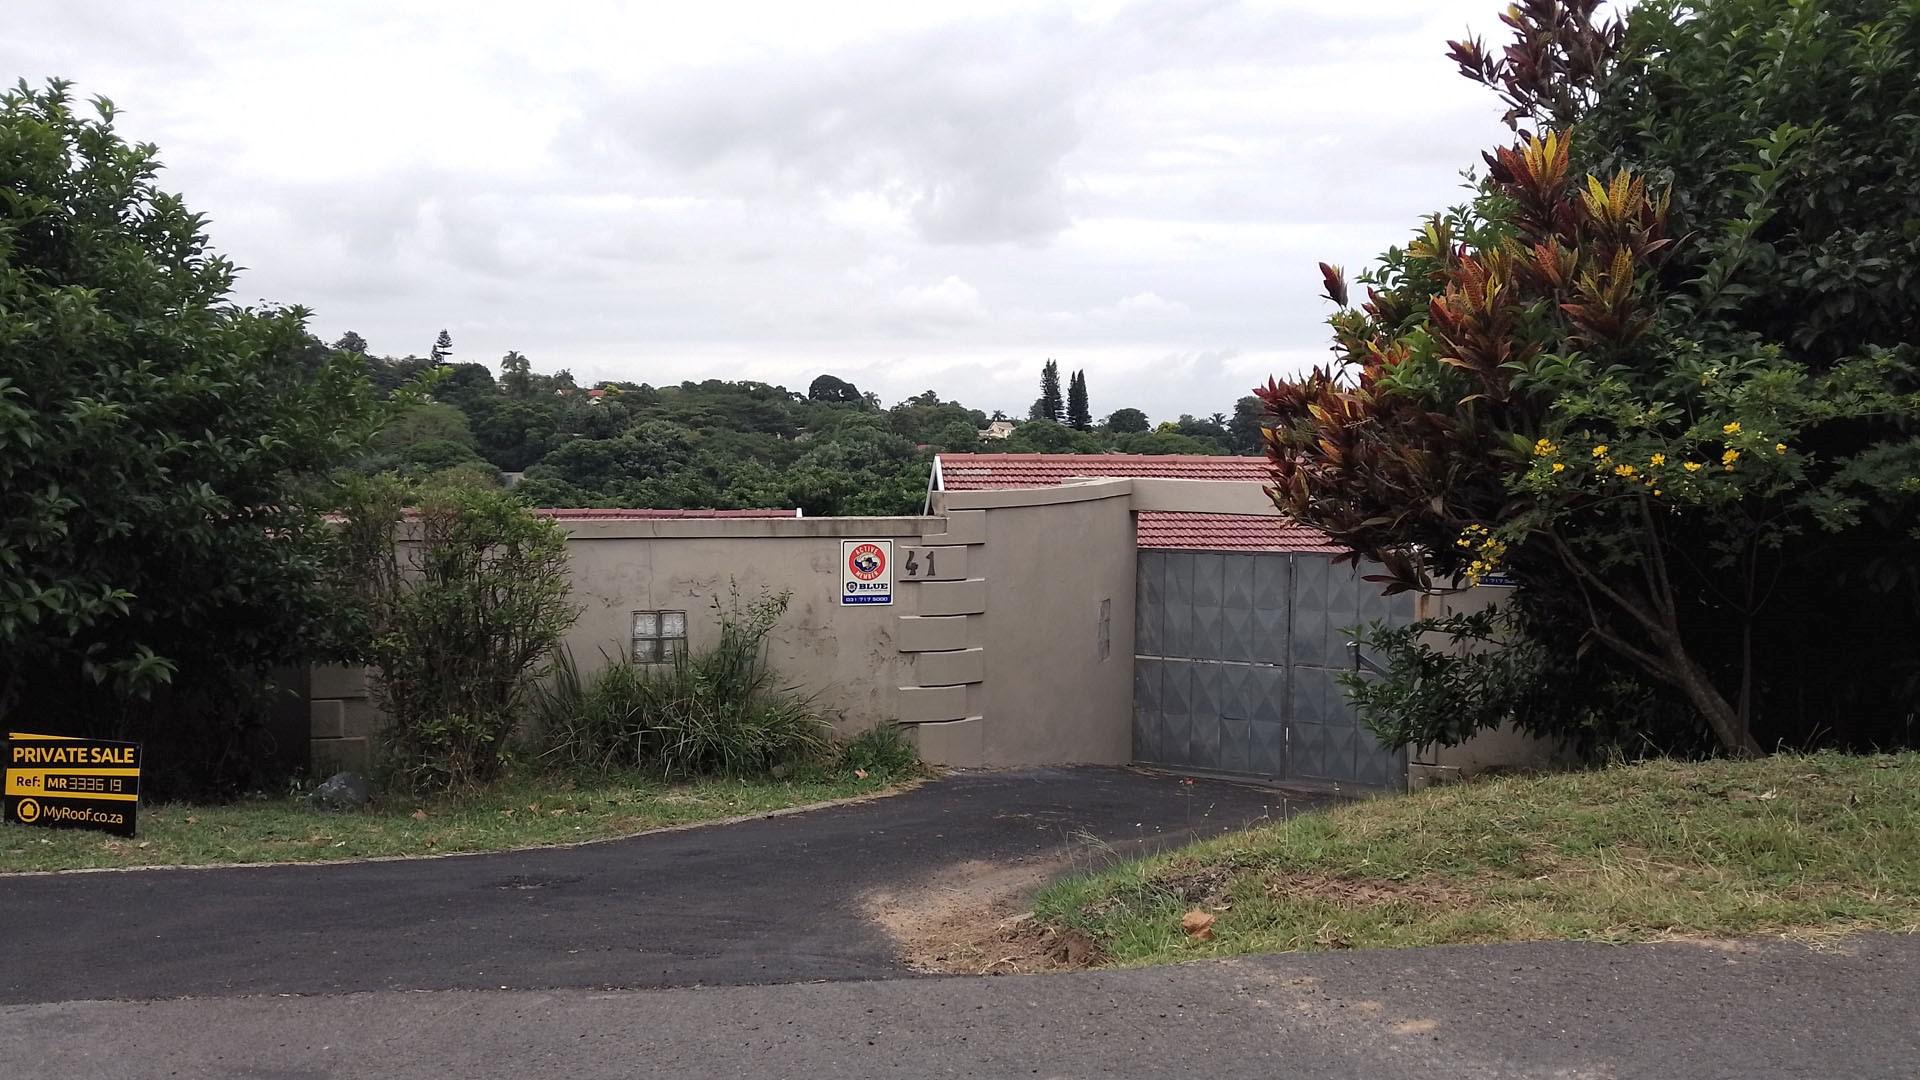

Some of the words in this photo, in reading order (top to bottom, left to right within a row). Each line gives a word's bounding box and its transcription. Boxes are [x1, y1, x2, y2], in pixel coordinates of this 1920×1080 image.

[855, 546, 879, 555] ACTIVE
[905, 551, 936, 576] 41
[856, 571, 879, 580] MEMBER
[13, 747, 88, 763] PRIVATE
[91, 747, 135, 763] SALE
[16, 776, 41, 787] Ref:
[43, 805, 124, 824] MyRoof.co.za
